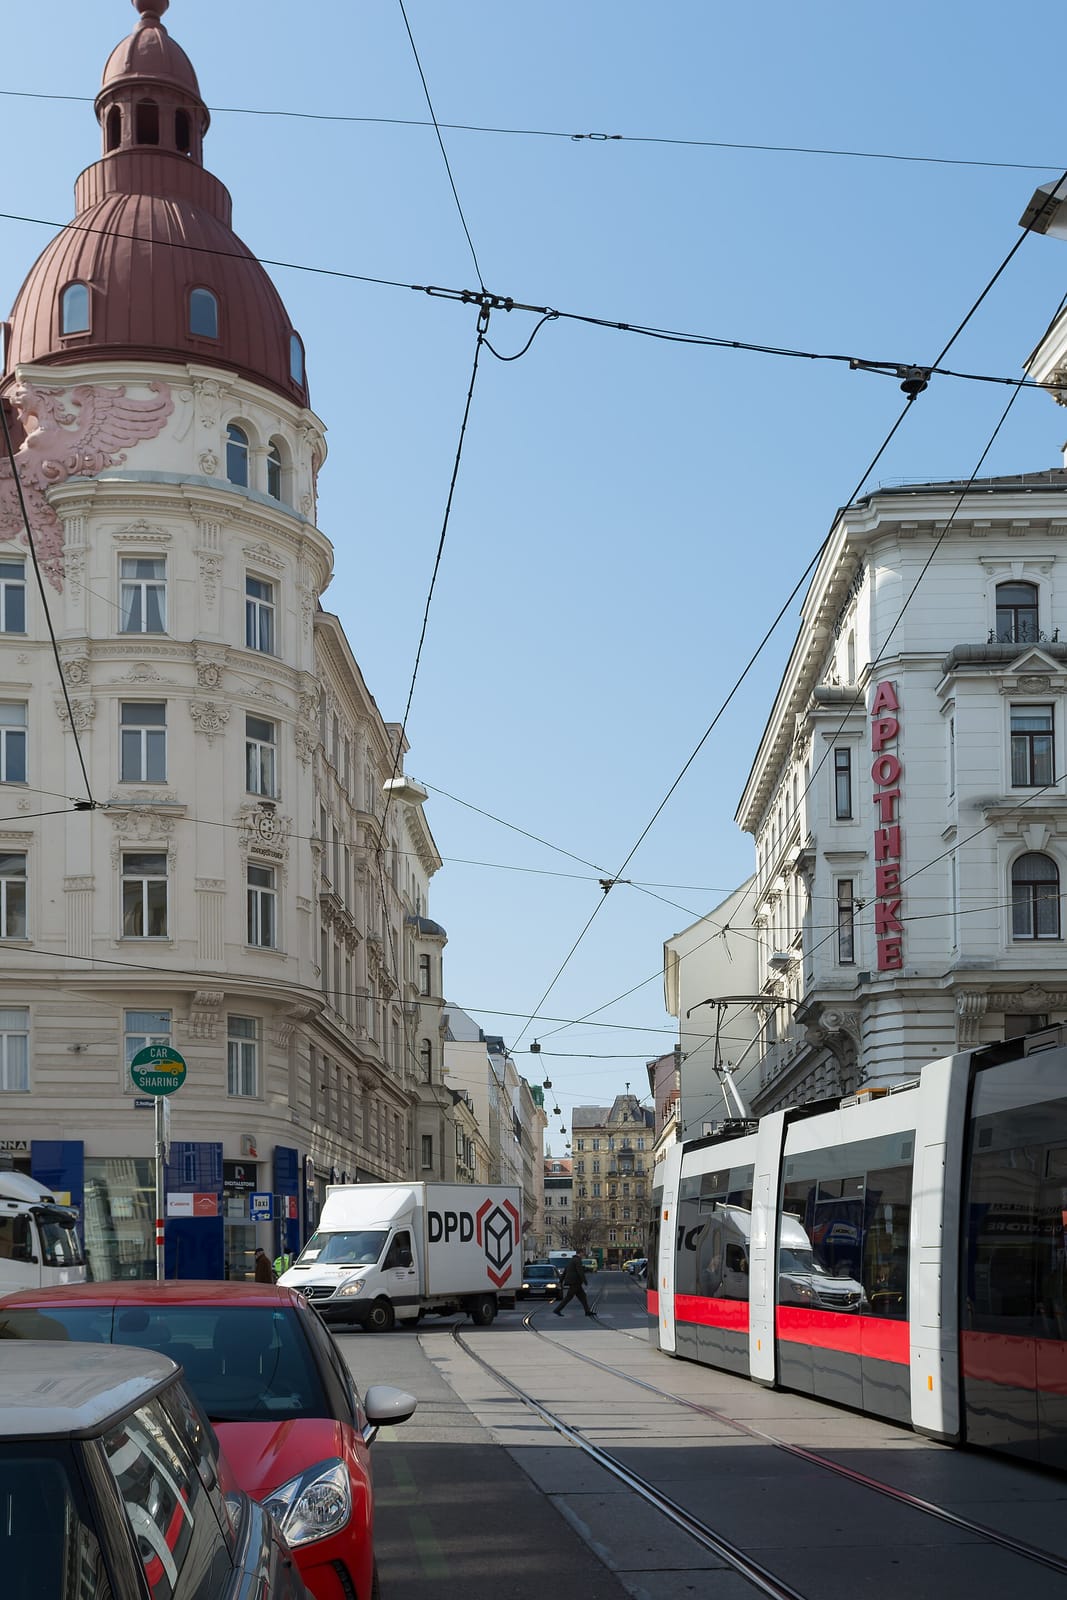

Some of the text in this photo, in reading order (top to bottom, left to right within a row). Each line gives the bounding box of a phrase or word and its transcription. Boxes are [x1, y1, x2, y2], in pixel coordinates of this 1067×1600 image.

[871, 681, 904, 971] APOTHEKE
[150, 1048, 168, 1057] CAR
[139, 1076, 178, 1088] SHARING
[254, 1198, 268, 1207] Taxi
[428, 1211, 474, 1243] DPD
